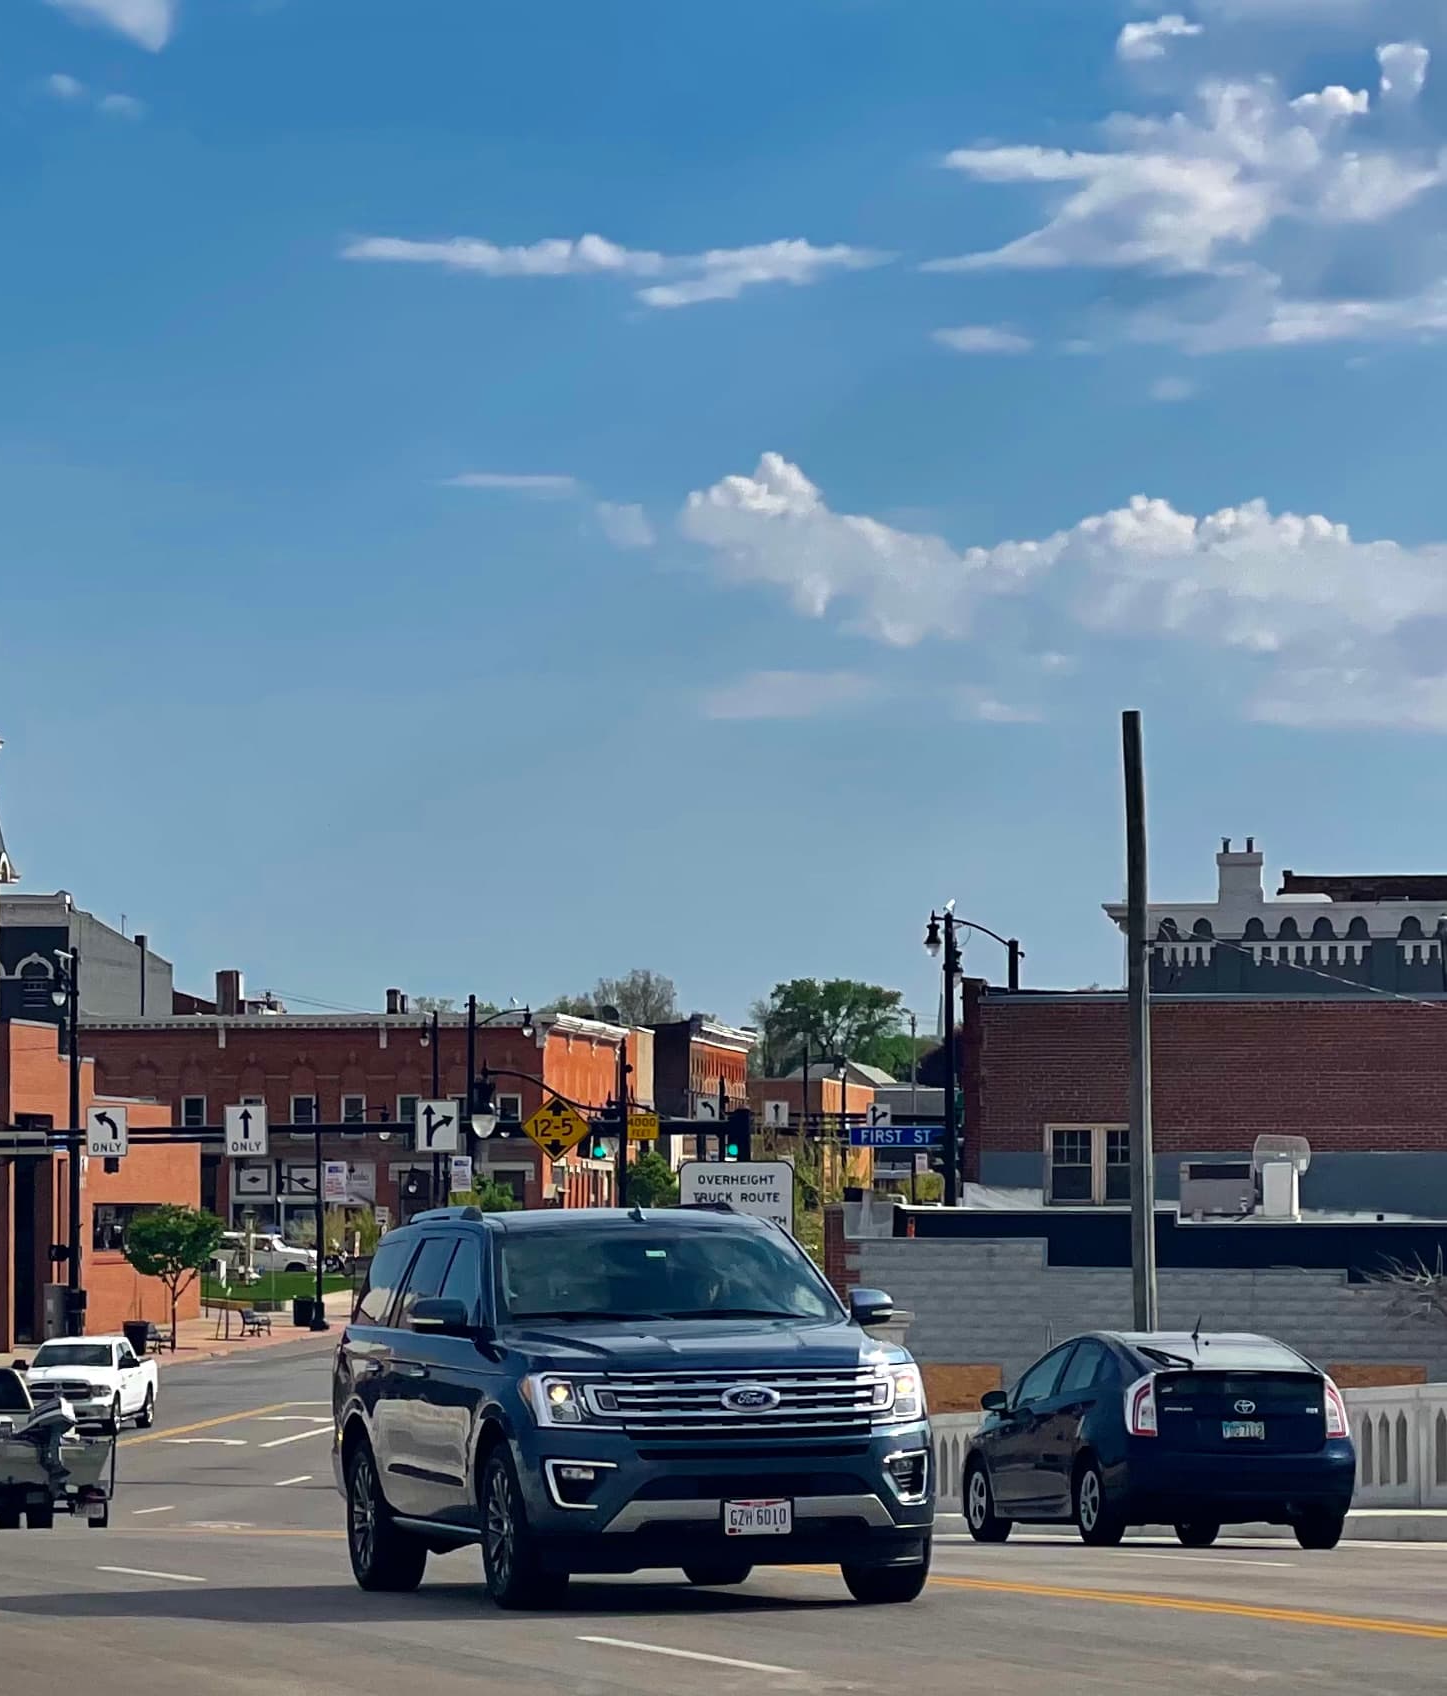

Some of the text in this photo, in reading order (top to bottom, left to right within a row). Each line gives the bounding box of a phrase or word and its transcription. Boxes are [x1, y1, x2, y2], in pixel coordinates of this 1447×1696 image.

[861, 1129, 931, 1143] FIRST ST
[92, 1142, 122, 1153] ONLY
[231, 1141, 261, 1152] ONLY
[697, 1174, 775, 1185] OVERHEIGHT
[693, 1192, 780, 1202] TRUCK ROUTE
[737, 1392, 766, 1405] Ford
[756, 1508, 786, 1525] 6010
